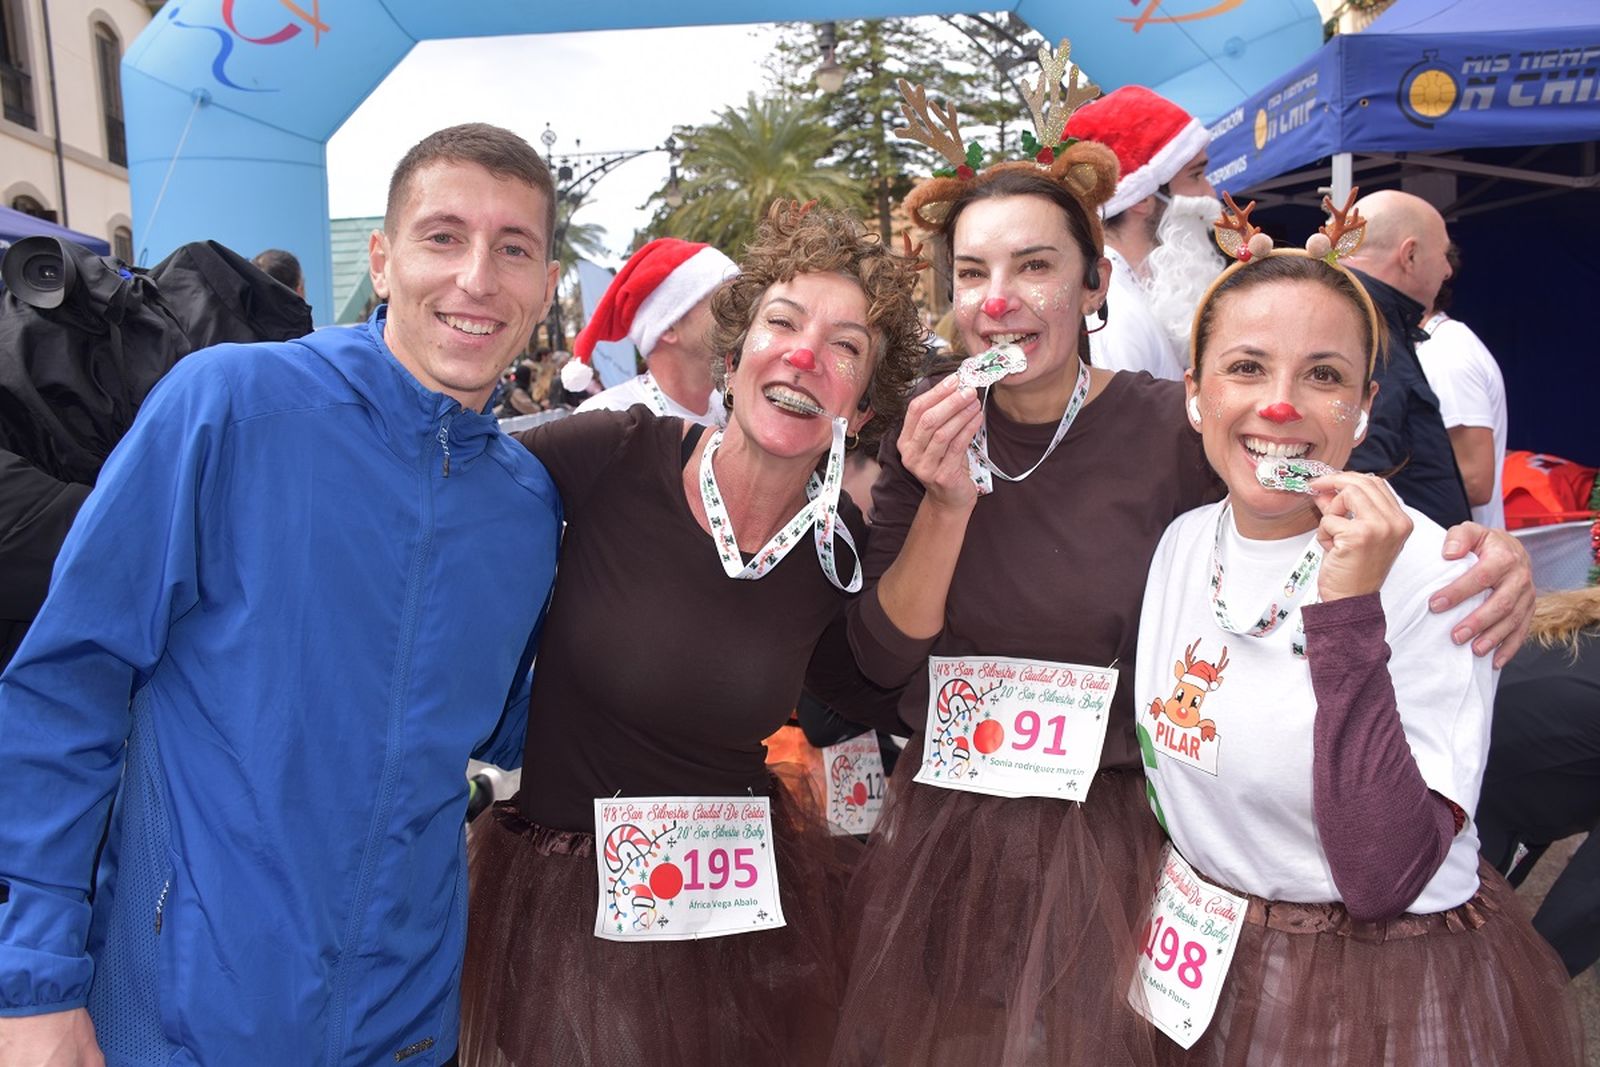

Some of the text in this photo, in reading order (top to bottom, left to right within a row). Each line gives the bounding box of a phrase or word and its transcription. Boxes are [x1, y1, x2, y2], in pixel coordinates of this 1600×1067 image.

[1461, 53, 1512, 75] MIS
[1508, 67, 1600, 108] CHI
[955, 661, 974, 677] San
[978, 663, 1016, 679] Silvestre
[1019, 665, 1058, 683] Ciudad
[1057, 668, 1077, 687] De
[1080, 673, 1110, 691] Ceuta
[1018, 687, 1036, 700] San
[1038, 688, 1075, 706] Silvestre
[1078, 693, 1104, 711] Baby
[1011, 710, 1067, 756] 91
[1155, 721, 1201, 761] PILAR
[990, 757, 1013, 768] Sonia
[622, 803, 643, 821] San
[648, 803, 689, 821] Silvestre
[692, 803, 721, 821] Ciudad
[723, 803, 738, 821] De
[741, 804, 765, 820] Ceuta
[694, 824, 709, 840] San
[712, 824, 740, 840] Silvestre
[742, 823, 765, 840] Baby
[683, 848, 758, 891] 195
[712, 899, 732, 911] Vega
[734, 897, 759, 908] Abalo
[1188, 886, 1202, 907] De
[1204, 896, 1238, 923] Ceuta
[1200, 918, 1230, 944] Baby
[1144, 915, 1208, 990] 198
[1168, 988, 1191, 1010] Flores
